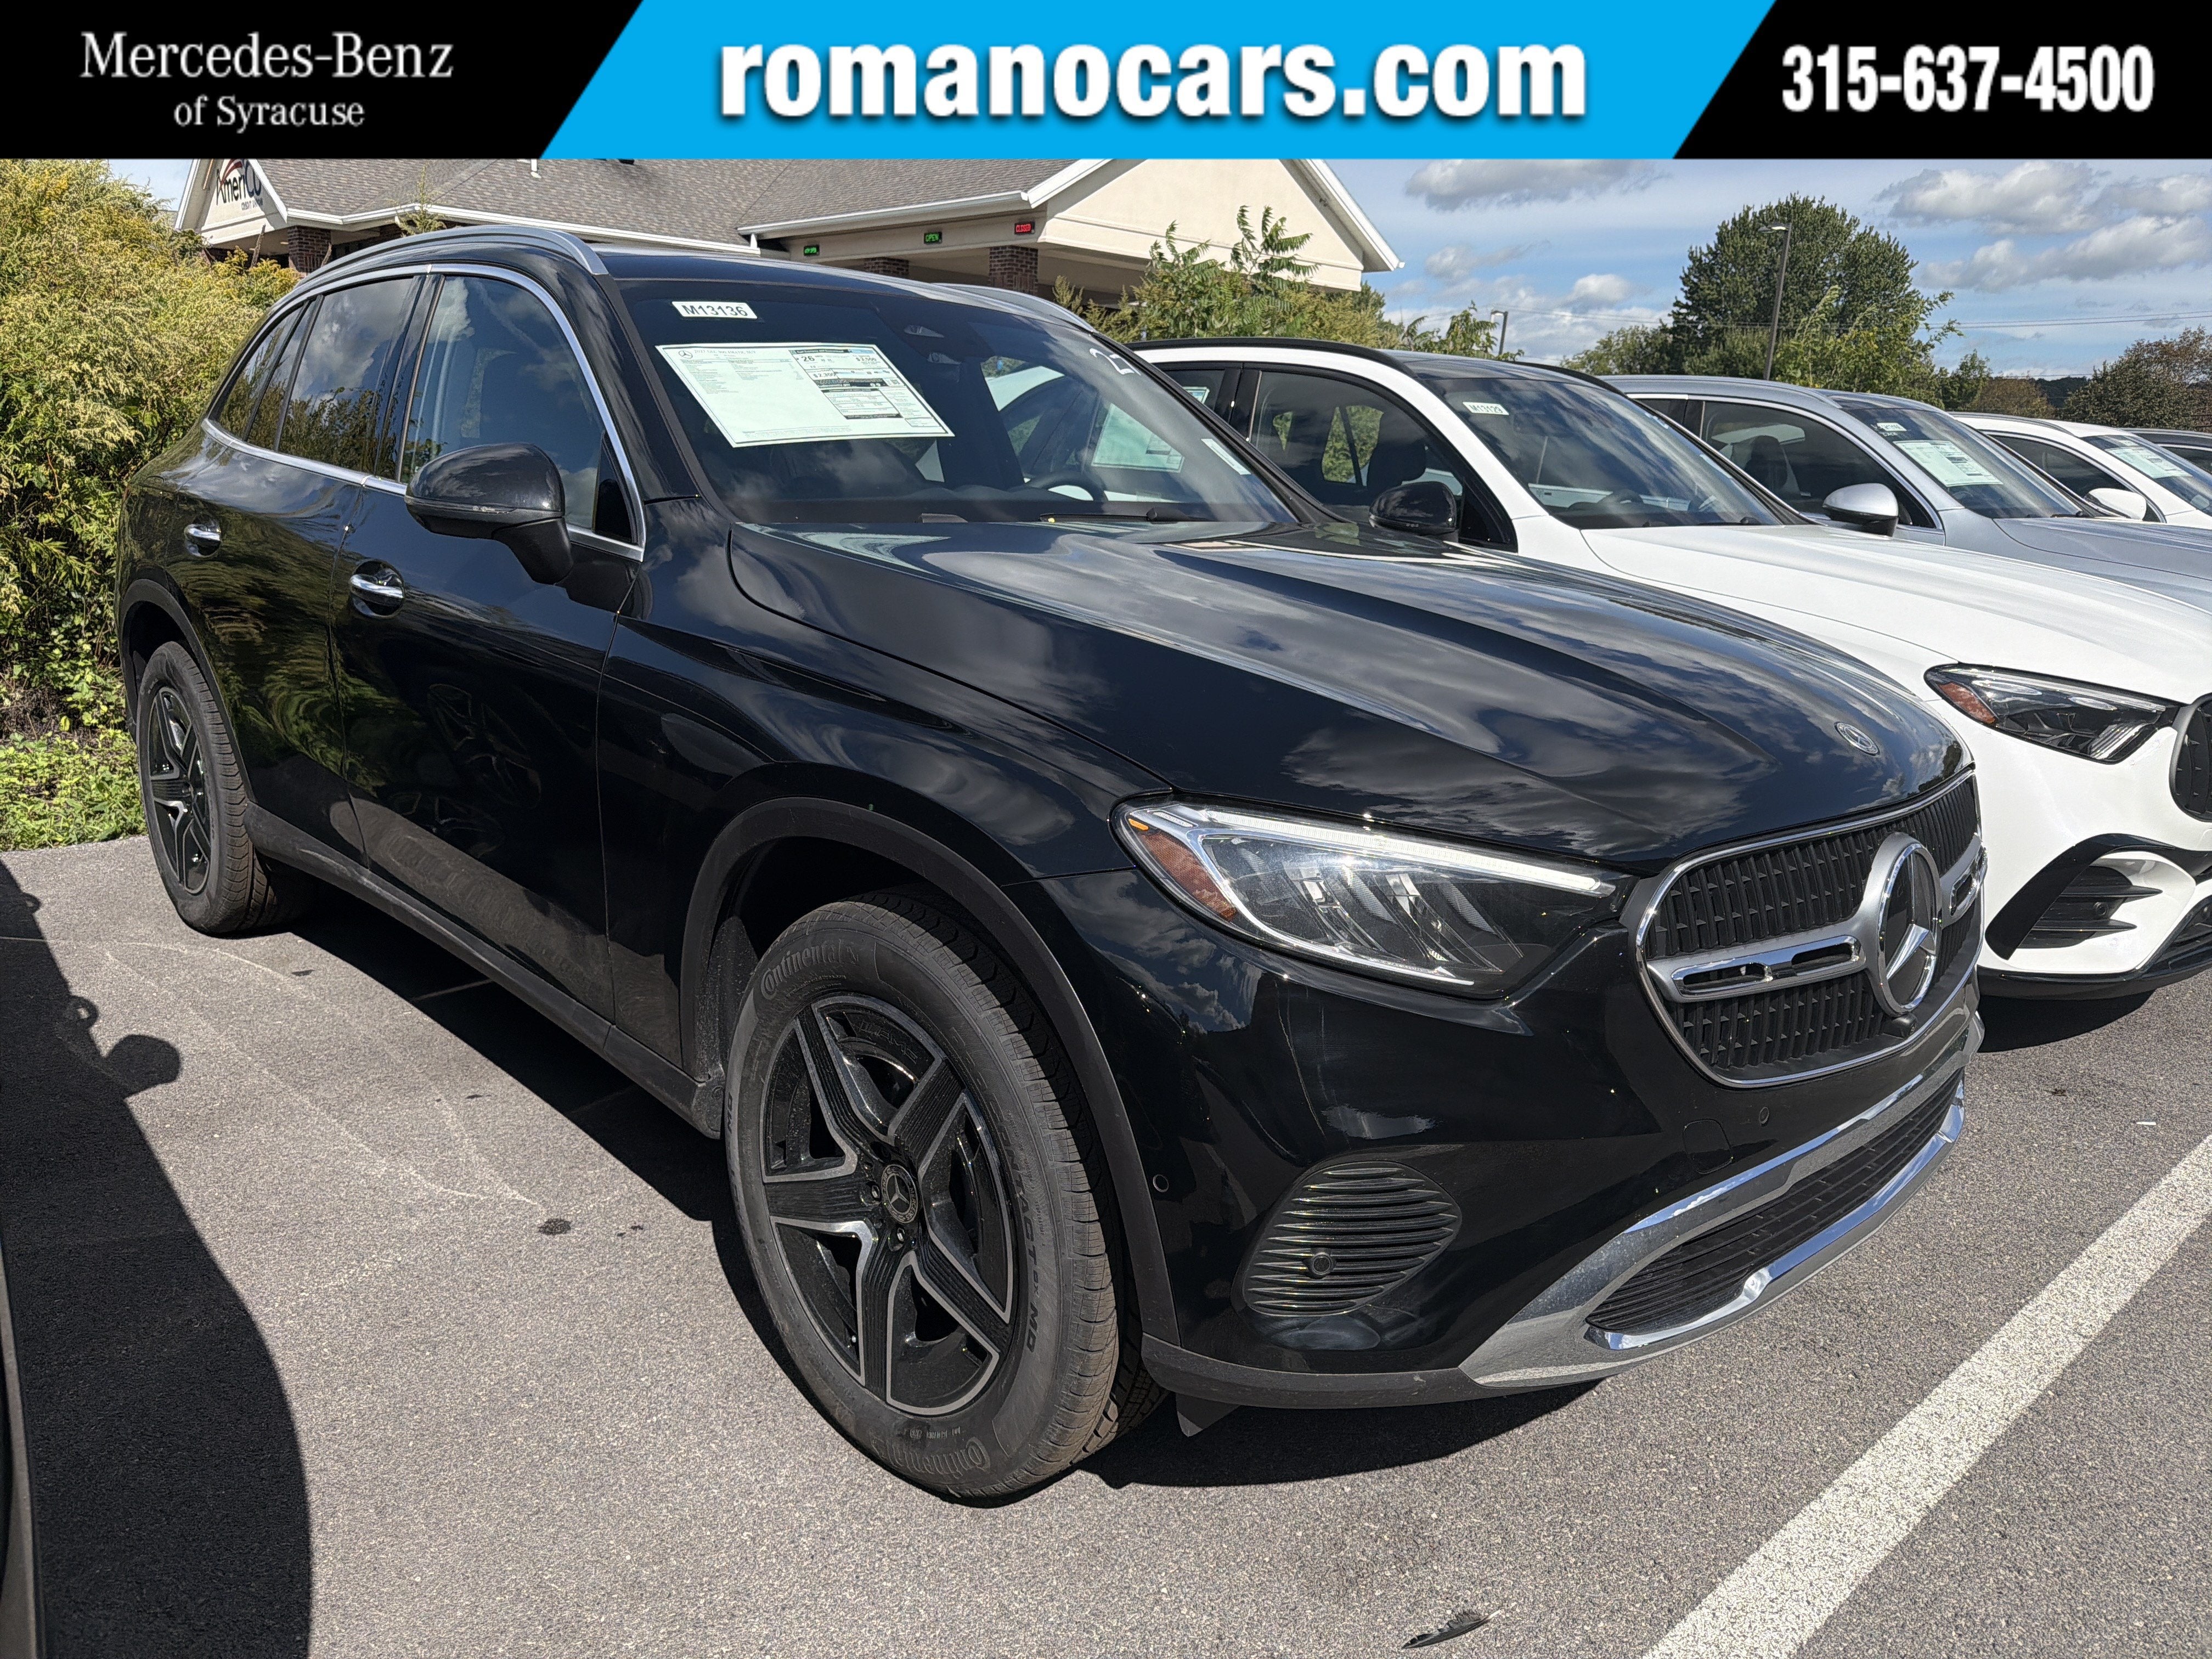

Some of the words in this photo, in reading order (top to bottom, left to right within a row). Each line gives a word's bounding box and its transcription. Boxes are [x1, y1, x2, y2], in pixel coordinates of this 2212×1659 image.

[681, 305, 748, 317] M13136
[1469, 405, 1503, 413] M13129
[760, 938, 842, 1000] Continental
